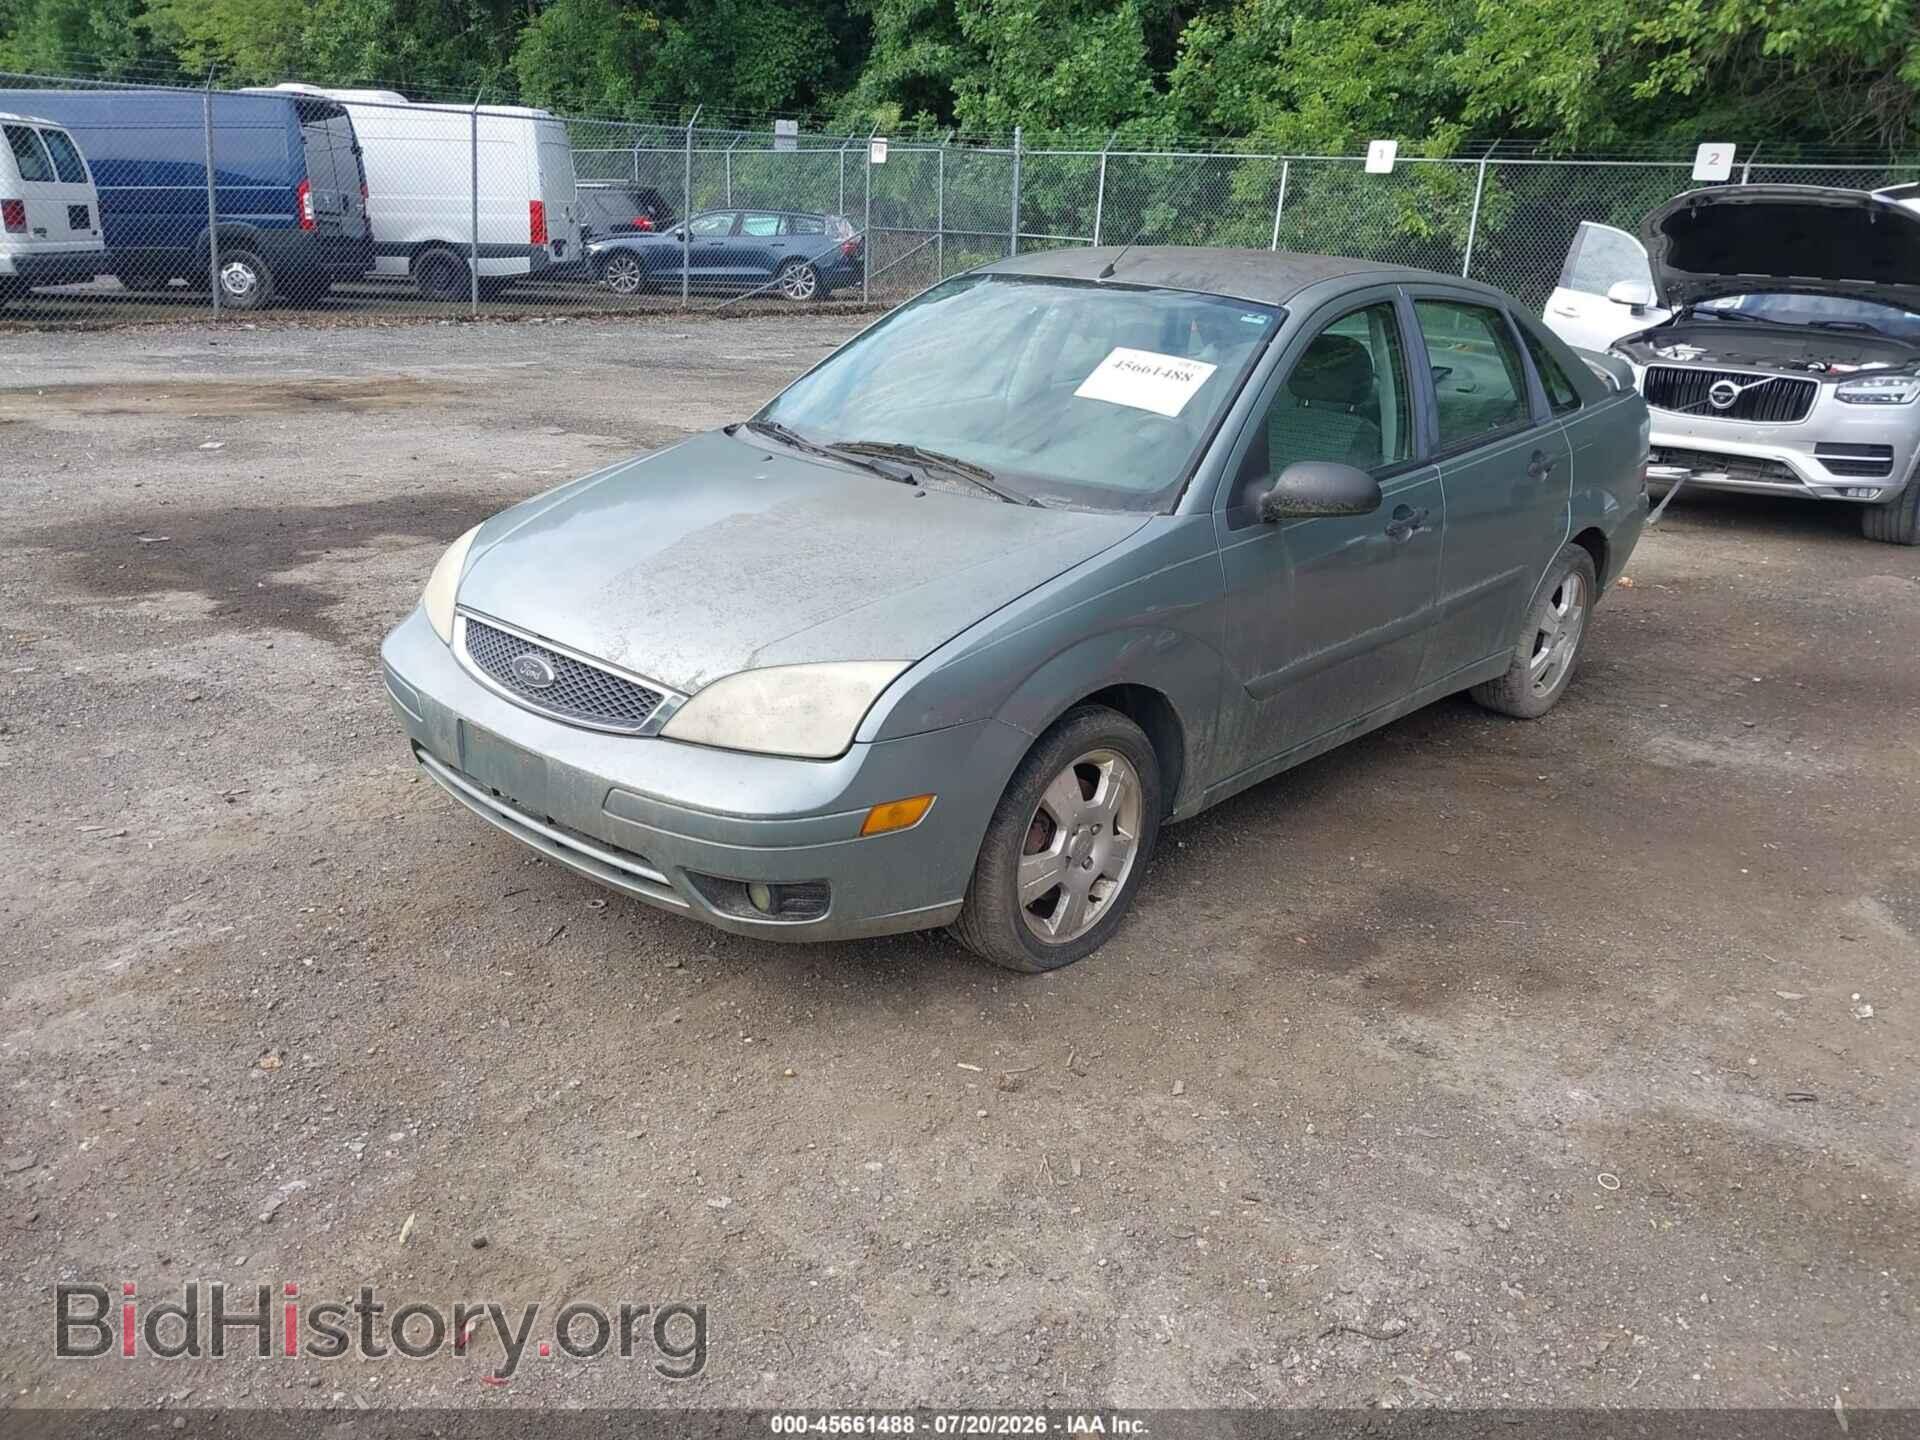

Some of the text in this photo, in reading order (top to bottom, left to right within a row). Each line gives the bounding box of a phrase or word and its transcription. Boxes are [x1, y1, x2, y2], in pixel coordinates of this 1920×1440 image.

[1708, 152, 1720, 166] 2
[1113, 360, 1194, 382] 45661488
[519, 660, 544, 681] Ford
